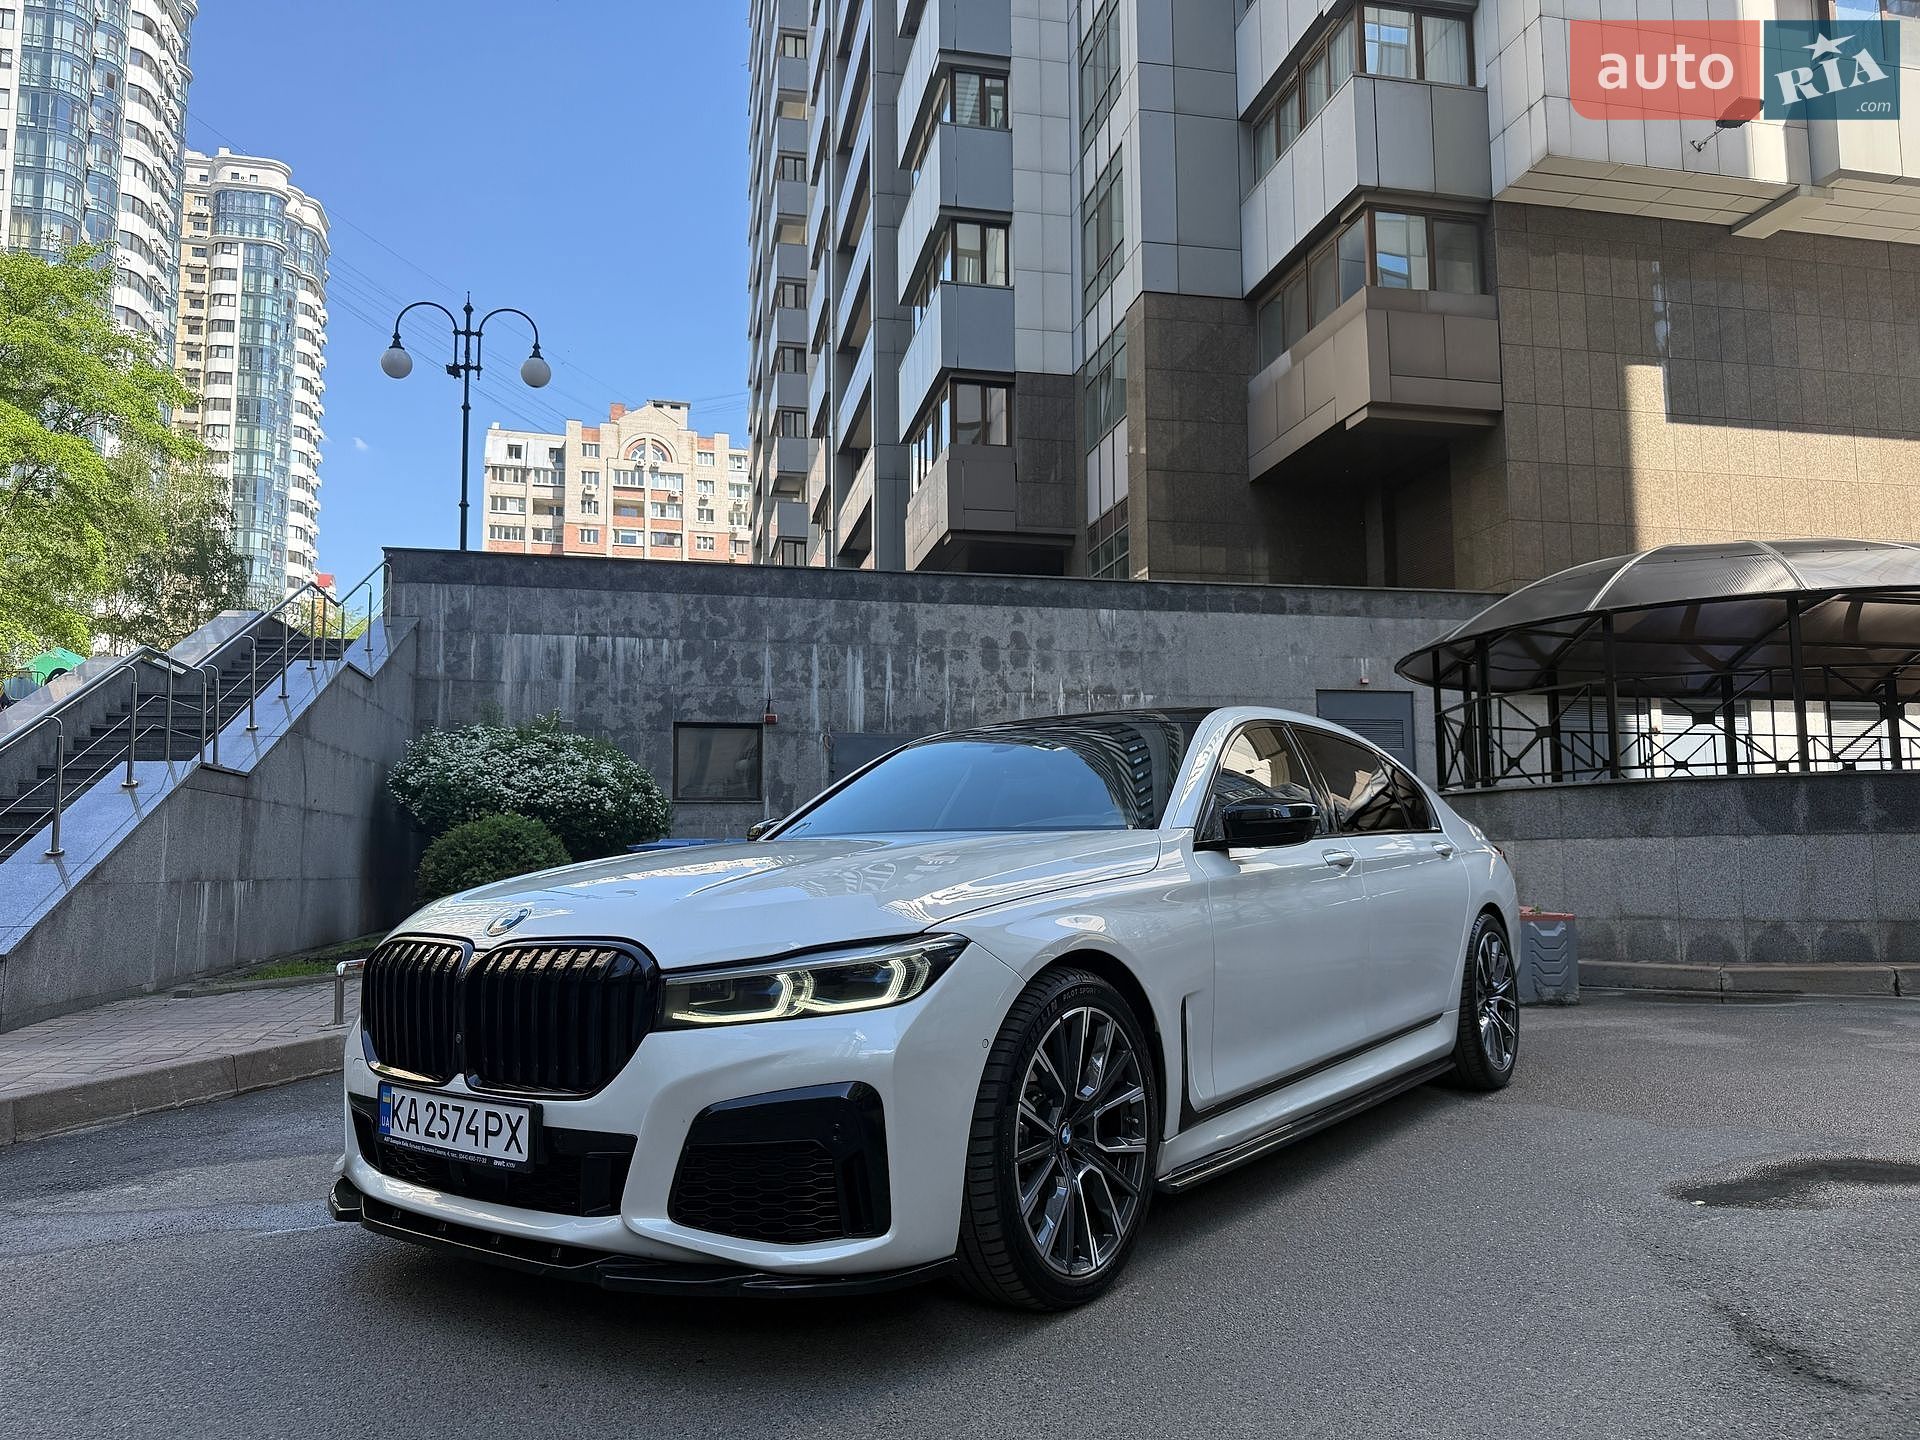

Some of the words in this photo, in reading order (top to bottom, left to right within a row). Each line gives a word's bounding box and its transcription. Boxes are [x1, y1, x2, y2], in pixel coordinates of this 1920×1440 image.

[381, 1115, 389, 1128] UA
[392, 1093, 419, 1135] KA
[424, 1101, 478, 1147] 2574
[484, 1110, 524, 1154] PX
